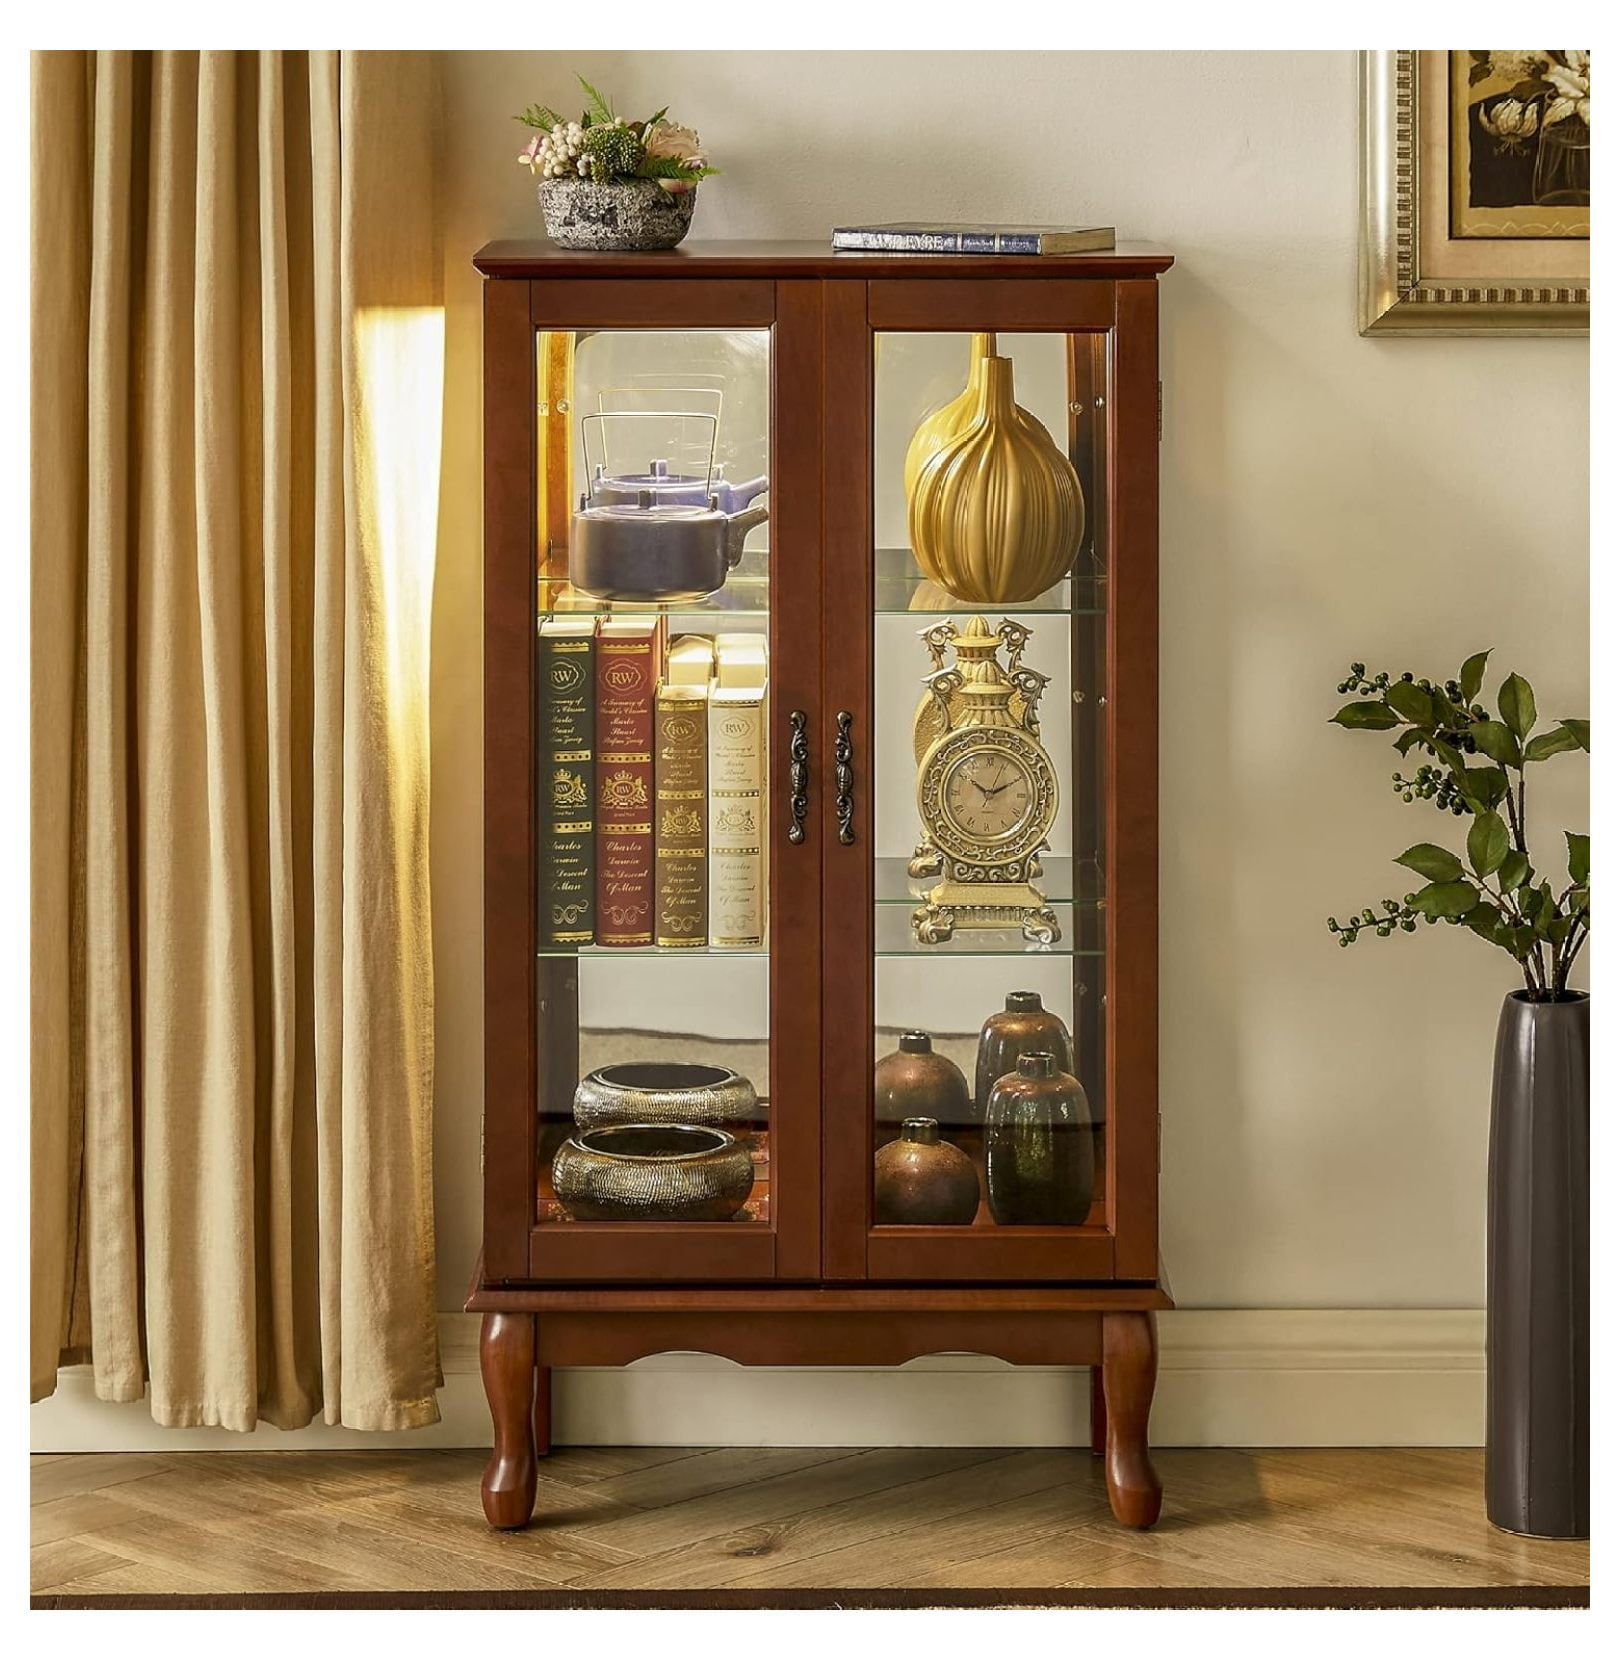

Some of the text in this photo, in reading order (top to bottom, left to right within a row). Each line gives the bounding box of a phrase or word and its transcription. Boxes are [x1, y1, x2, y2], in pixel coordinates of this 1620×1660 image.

[906, 234, 943, 250] EYRE
[612, 672, 635, 684] RW
[726, 723, 745, 733] RW
[606, 841, 642, 852] Charles
[616, 869, 648, 879] Descent
[618, 882, 642, 892] Man
